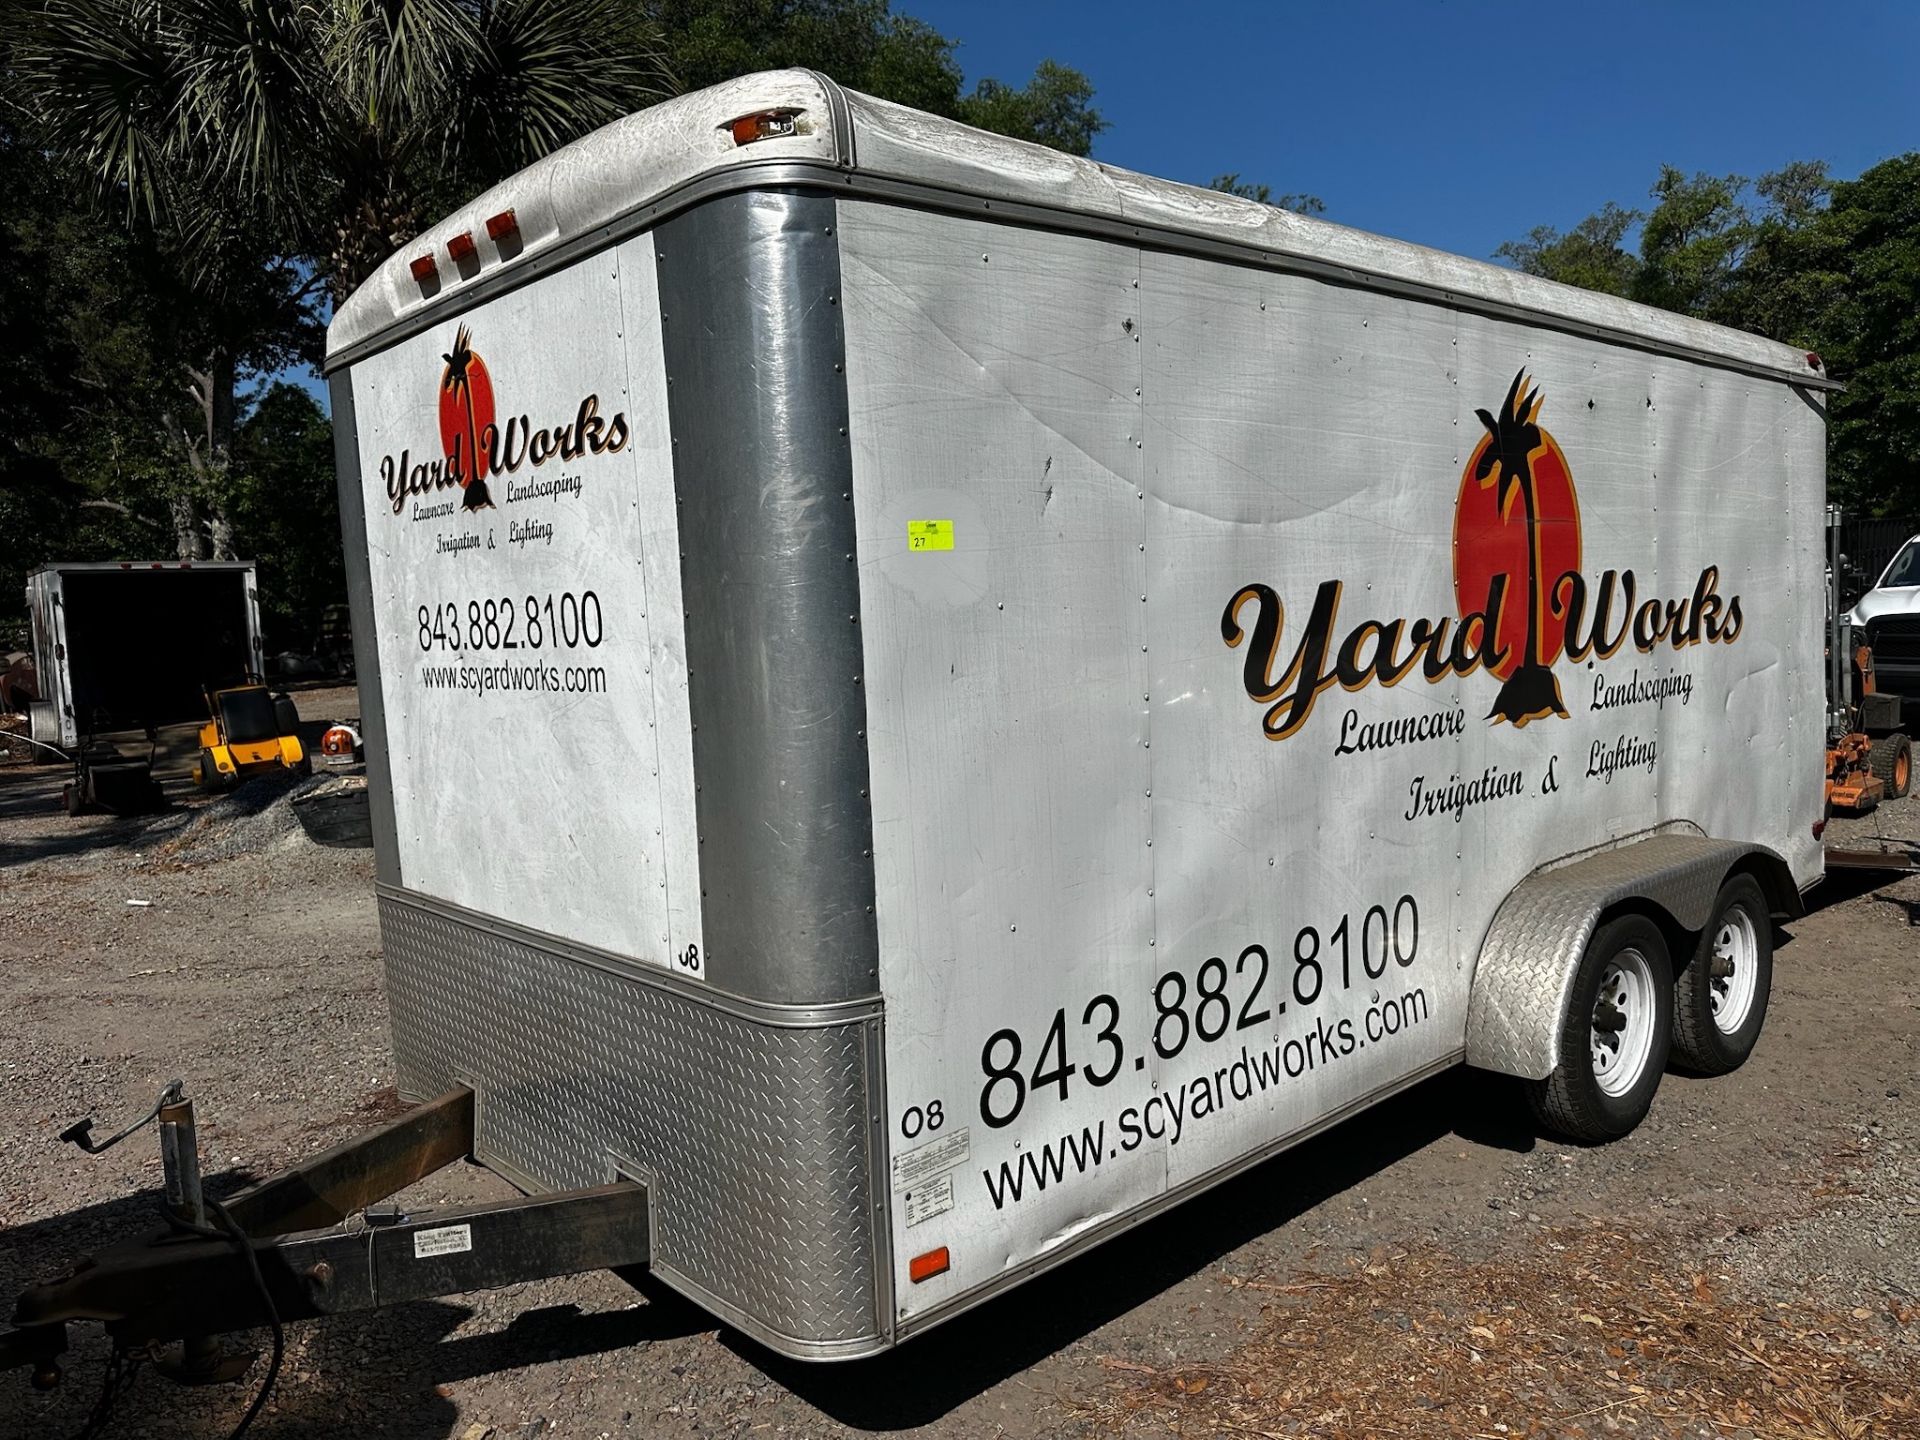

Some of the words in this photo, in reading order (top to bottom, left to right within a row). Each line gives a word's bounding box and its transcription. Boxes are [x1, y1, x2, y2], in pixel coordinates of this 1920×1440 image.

[379, 432, 466, 516] Yard
[480, 393, 630, 473] Works
[412, 501, 454, 522] Lawncare
[506, 473, 583, 503] Landscaping
[436, 532, 481, 558] Irrigation
[487, 528, 496, 549] &
[509, 520, 553, 546] Lighting
[914, 537, 925, 548] 27
[418, 590, 604, 651] 843.882.8100
[1220, 573, 1511, 741] Yard
[1550, 564, 1744, 664] Works
[422, 659, 606, 698] www.scyardworks.com
[1334, 708, 1466, 757] Lawncare
[1590, 669, 1693, 711] Landscaping
[1404, 767, 1524, 822] Irrigation
[1541, 756, 1559, 795] &
[1585, 735, 1657, 785] Lighting
[979, 894, 1419, 1129] 843.882.8100
[983, 987, 1428, 1211] www.scyardworks.com
